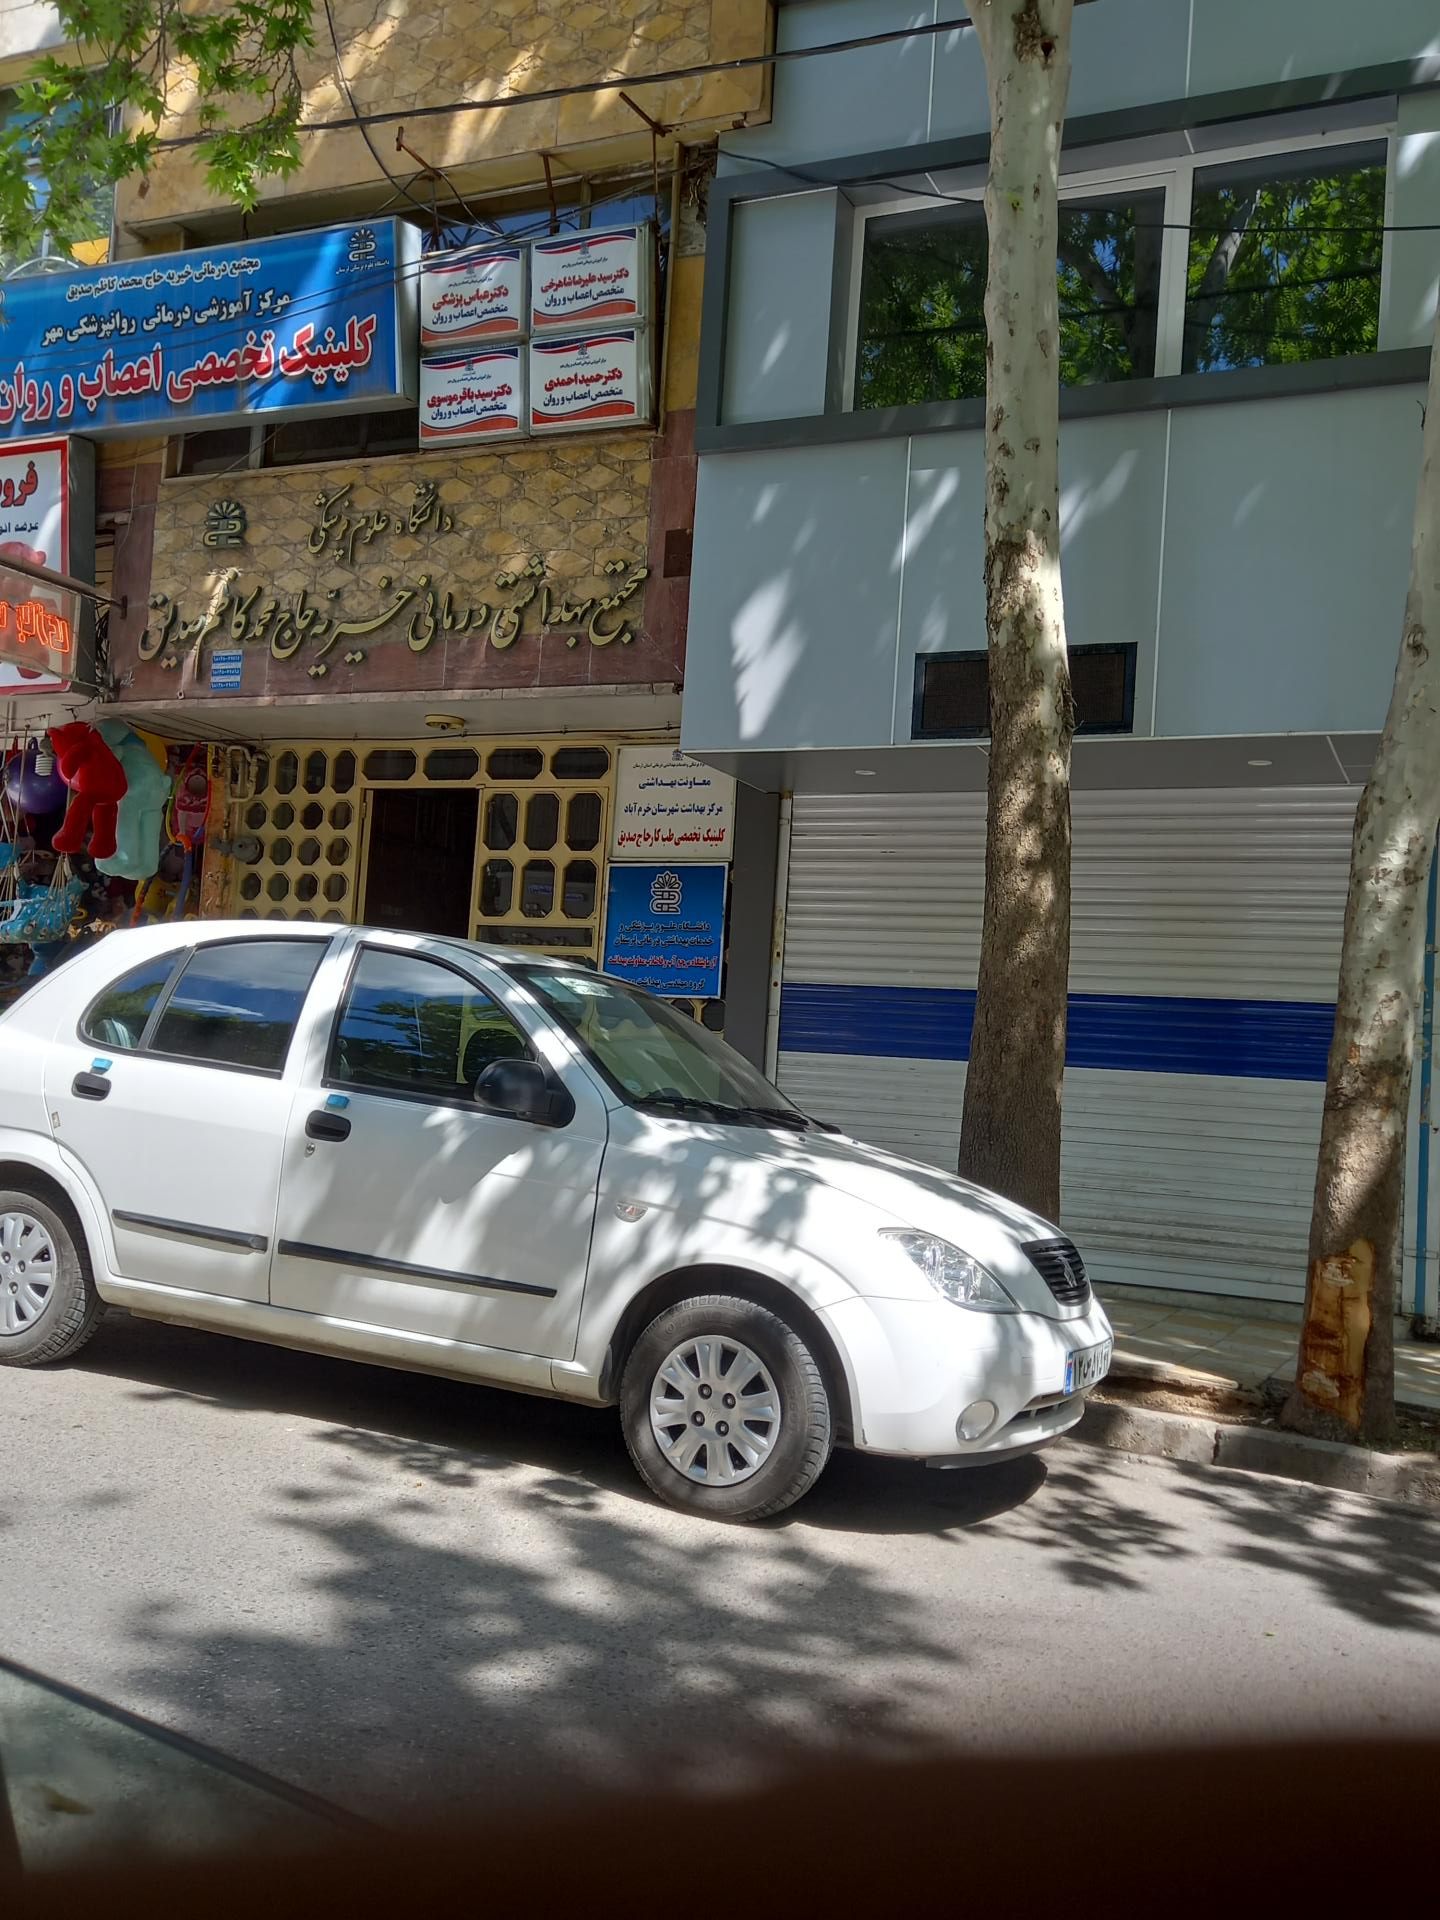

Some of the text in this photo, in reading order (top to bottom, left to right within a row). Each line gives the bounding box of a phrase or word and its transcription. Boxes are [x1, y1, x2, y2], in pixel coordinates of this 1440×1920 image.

[66, 258, 260, 301] مجتمع درمانی خیریه حاج محمد کاظم صدیق
[597, 272, 612, 284] سید
[611, 267, 630, 283] دکتر
[432, 284, 509, 310] دکتر عباس پزشکی
[544, 294, 562, 307] روان
[567, 289, 592, 304] اعصاب
[592, 285, 624, 300] متخصص
[142, 302, 191, 331] درمانی
[195, 290, 252, 324] آموزشی
[453, 306, 477, 321] اعصاب
[477, 304, 508, 318] متخصص
[66, 311, 137, 342] روانپزشکی
[432, 312, 448, 325] روان
[42, 326, 64, 346] مهر
[0, 313, 376, 424] کلینیک تخصصی اعصاب و روان
[544, 367, 623, 392] دکتر حمید احمدی
[427, 383, 512, 408] دکتر سید باقر موسوی
[543, 394, 560, 407] روان
[565, 389, 591, 404] اعصاب
[591, 387, 623, 402] متخصص
[431, 408, 447, 421] روان
[452, 404, 476, 418] اعصاب
[476, 401, 507, 415] متخصص
[308, 482, 453, 563] دانشگاه علوم پزشکی
[490, 554, 594, 648] بهداشتی
[588, 559, 650, 646] مجتمع
[246, 600, 280, 641] محمد
[408, 575, 489, 651] درمانی
[138, 594, 206, 669] صدیق
[193, 572, 262, 681] کاظم
[270, 589, 318, 660] حاج
[639, 777, 711, 789] معاونت بهداشتی
[624, 802, 723, 816] مرکز بهداشت شهرستان خرم آباد
[618, 827, 725, 847] کلینیک تخصصی طب کار حاج صدیق
